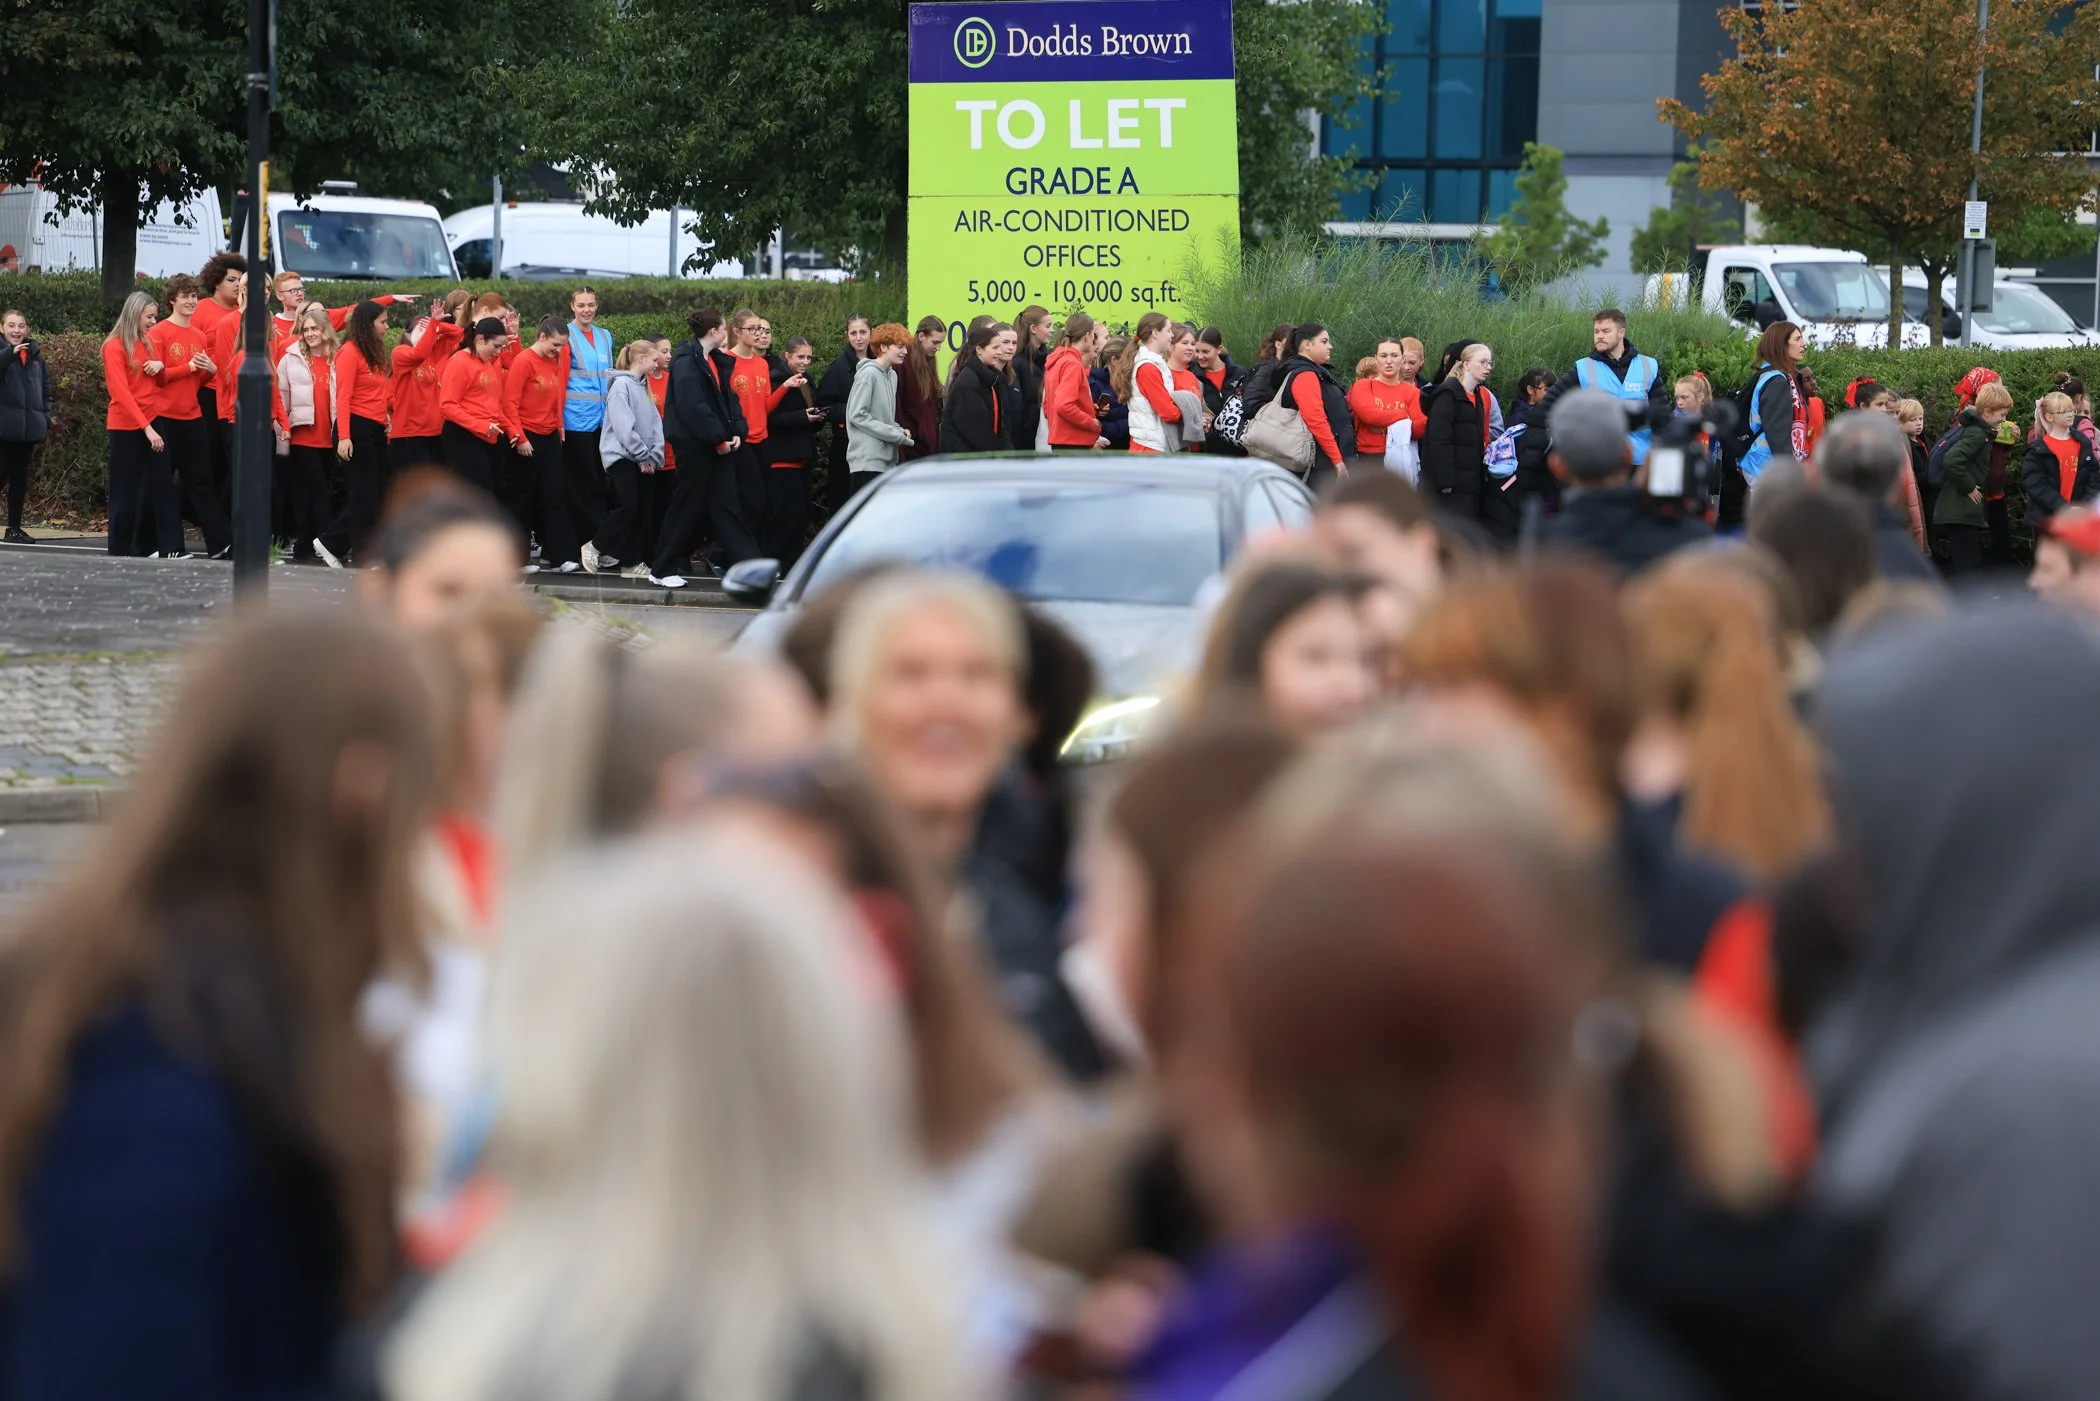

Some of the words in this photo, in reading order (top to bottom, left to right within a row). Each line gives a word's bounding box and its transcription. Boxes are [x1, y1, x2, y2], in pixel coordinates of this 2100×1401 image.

[1007, 24, 1092, 57] Dodds
[1101, 26, 1193, 55] Brown
[956, 99, 1046, 150] TO
[1069, 98, 1187, 149] LET
[1005, 167, 1112, 195] GRADE
[1117, 167, 1140, 195] A
[954, 209, 1190, 233] AIR-CONDITIONED
[1023, 245, 1122, 267] OFFICES
[968, 280, 1026, 305] 5,000
[1054, 280, 1123, 304] 10,000
[1130, 280, 1182, 310] sq.ft.
